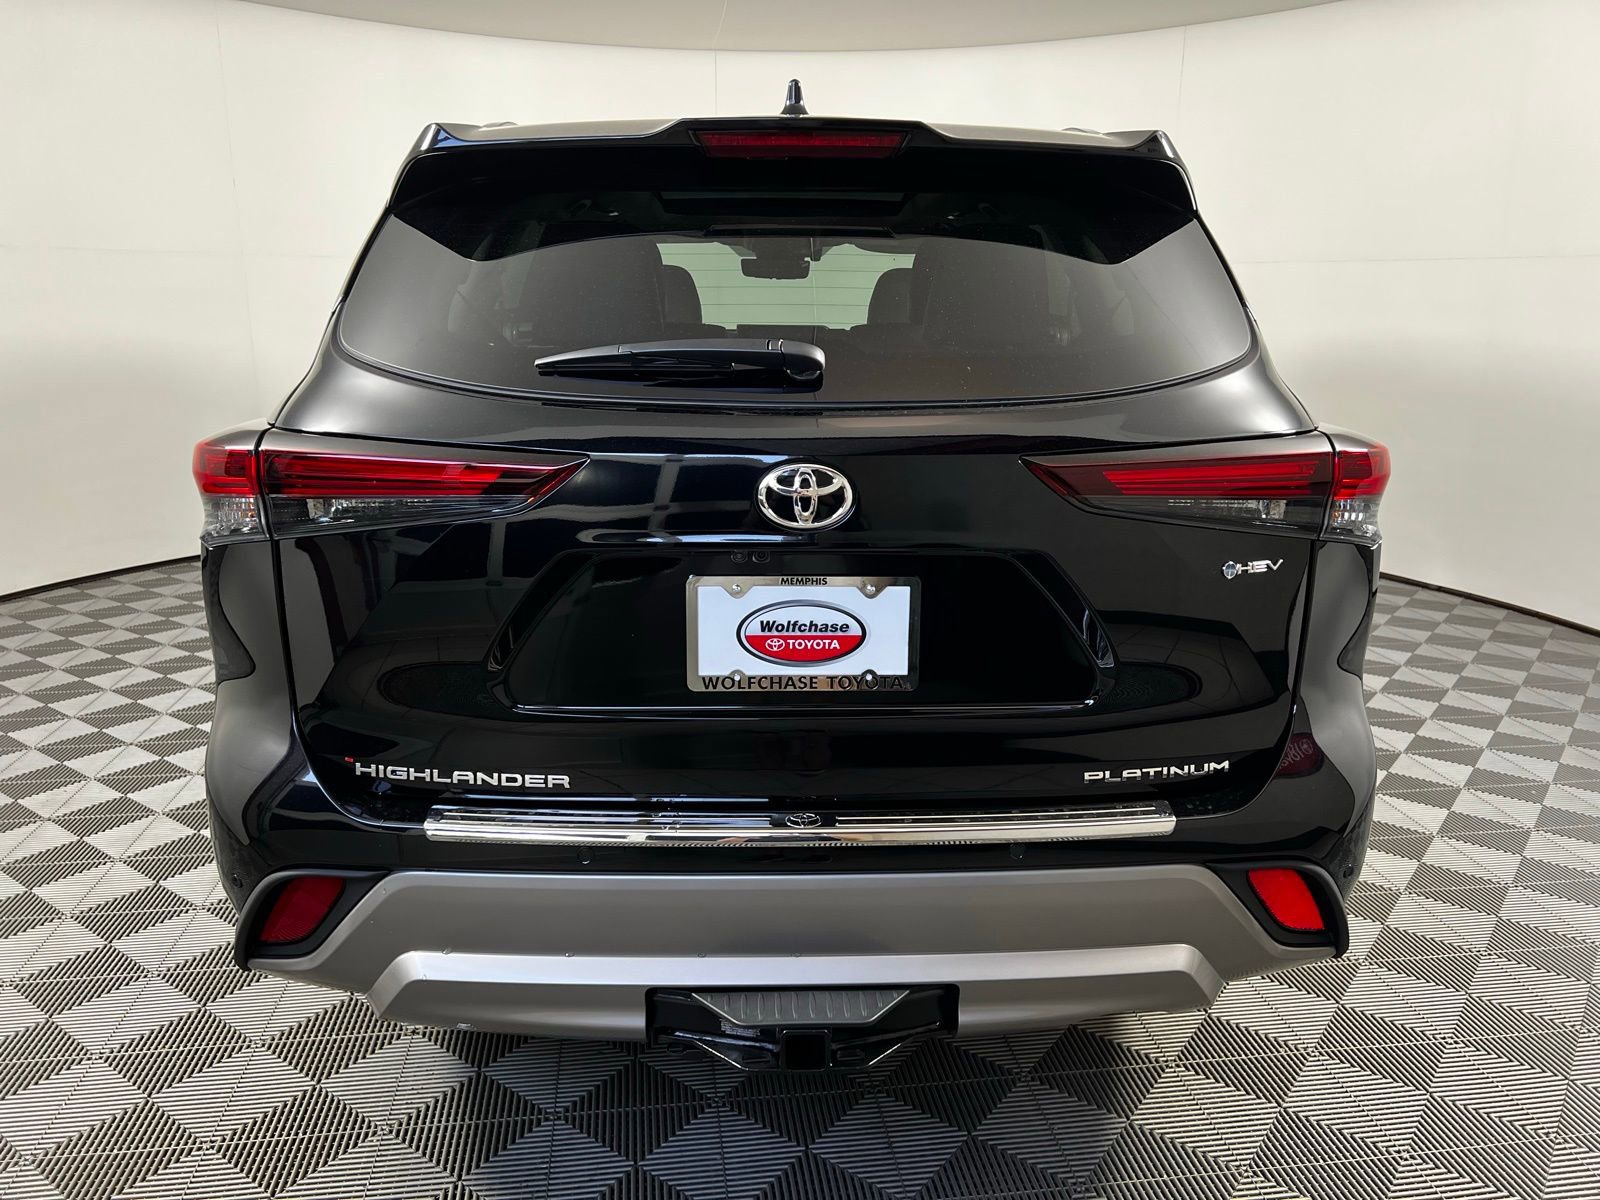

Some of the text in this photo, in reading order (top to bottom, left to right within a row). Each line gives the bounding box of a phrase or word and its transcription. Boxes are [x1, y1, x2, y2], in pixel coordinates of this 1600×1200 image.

[1236, 559, 1284, 575] HEV
[780, 577, 828, 586] MEMPHIS
[760, 620, 850, 633] Wolfchase
[787, 639, 840, 650] TOYOTA
[702, 676, 904, 690] WOLFCHASE TOYOTA
[355, 762, 571, 789] HIGHLANDER
[1083, 760, 1230, 783] PLATINUM
